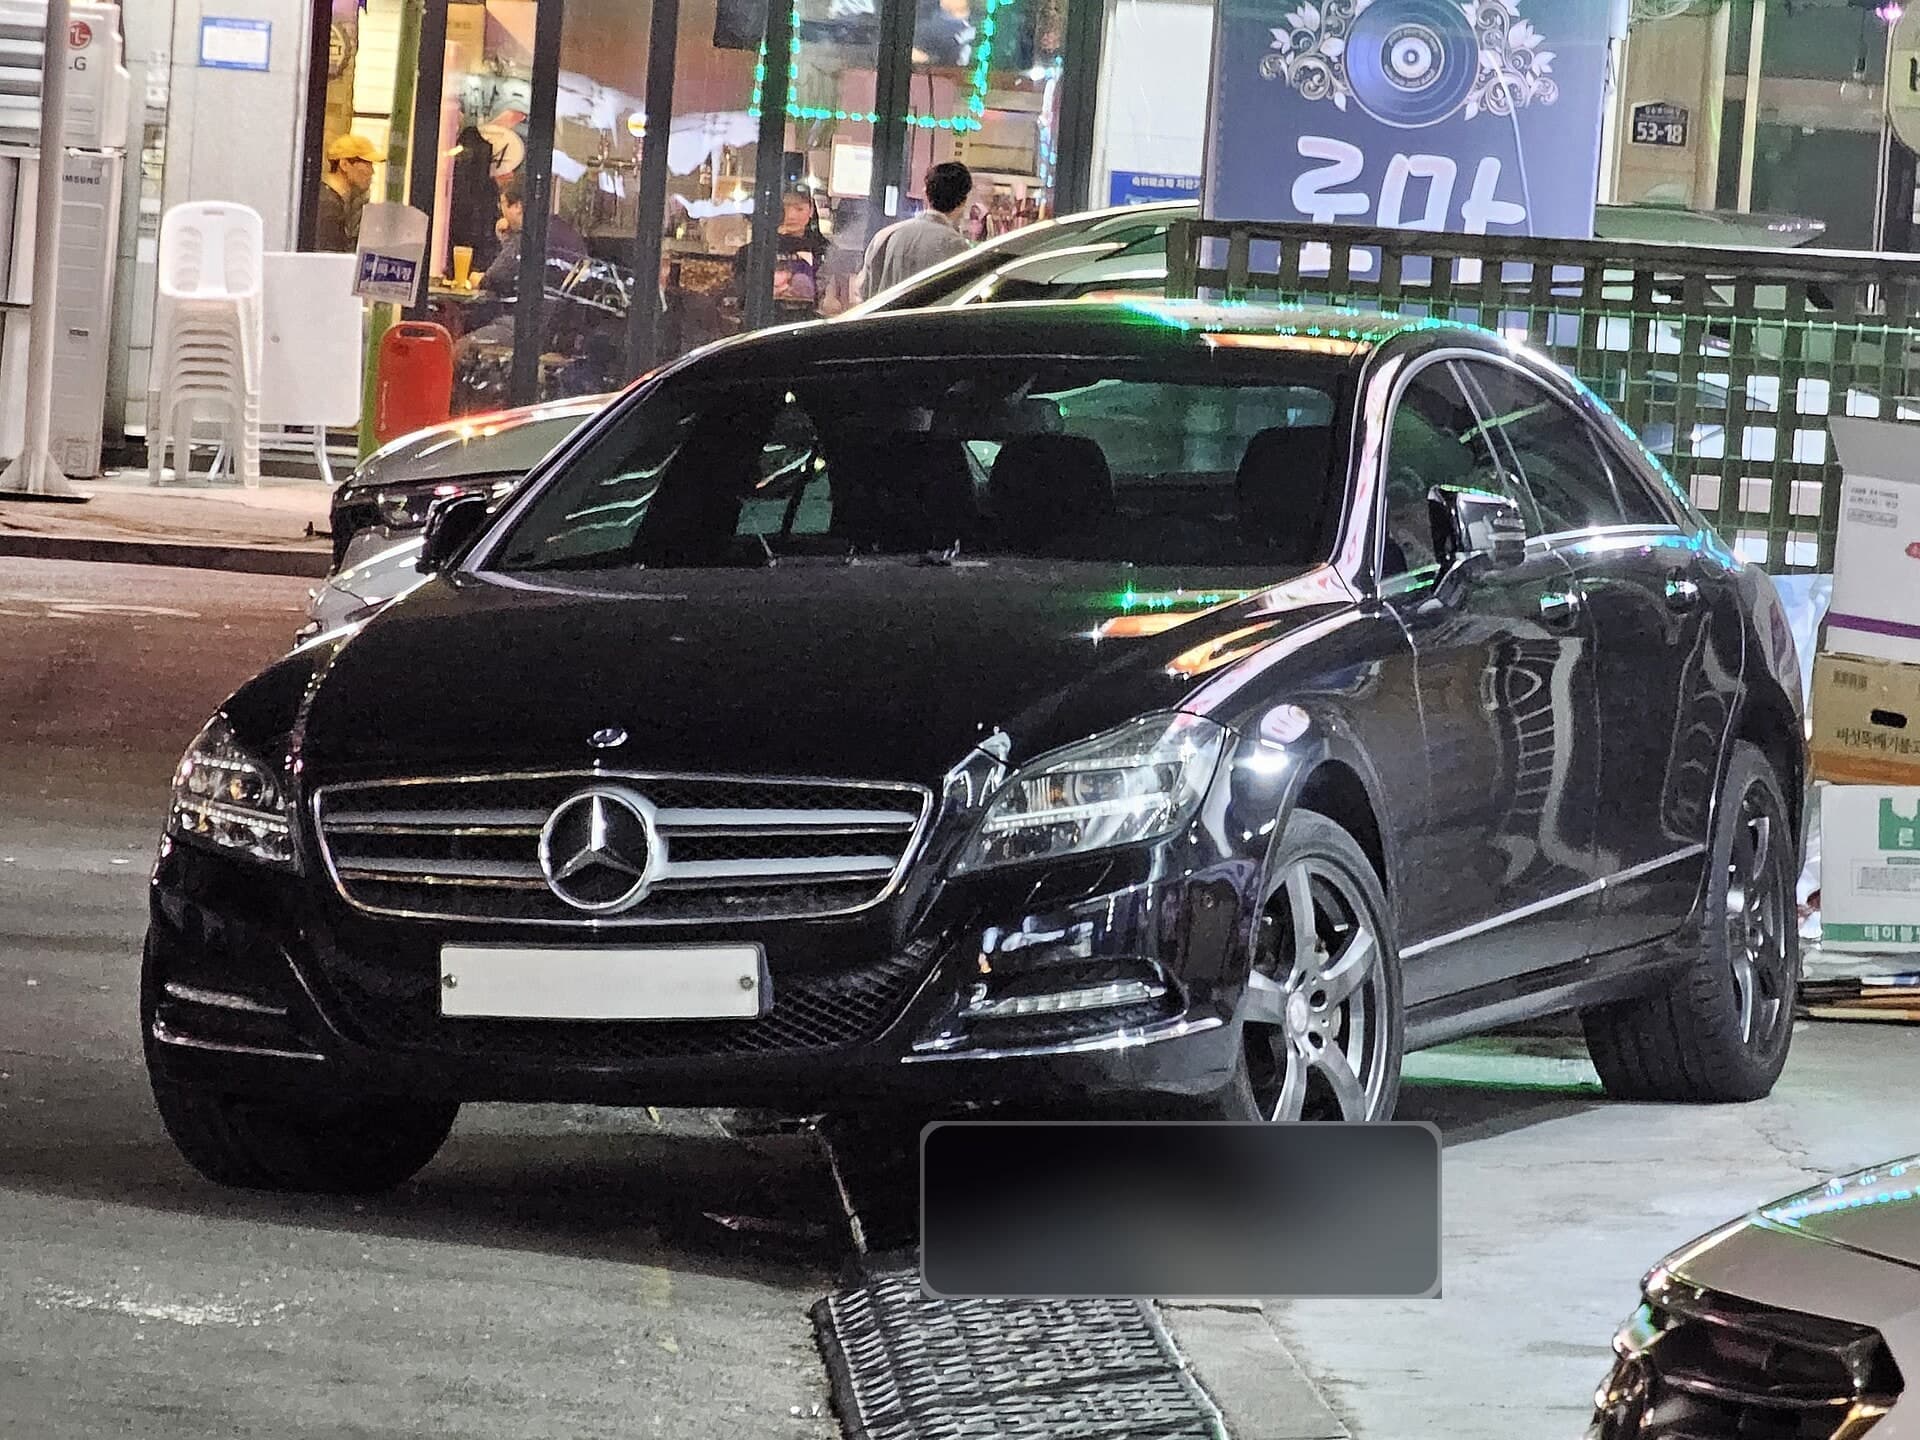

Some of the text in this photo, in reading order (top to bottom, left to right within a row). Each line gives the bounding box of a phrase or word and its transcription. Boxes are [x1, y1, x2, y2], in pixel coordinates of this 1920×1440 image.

[68, 56, 87, 71] G
[1636, 122, 1683, 144] 53-18
[62, 175, 101, 185] MSUNG
